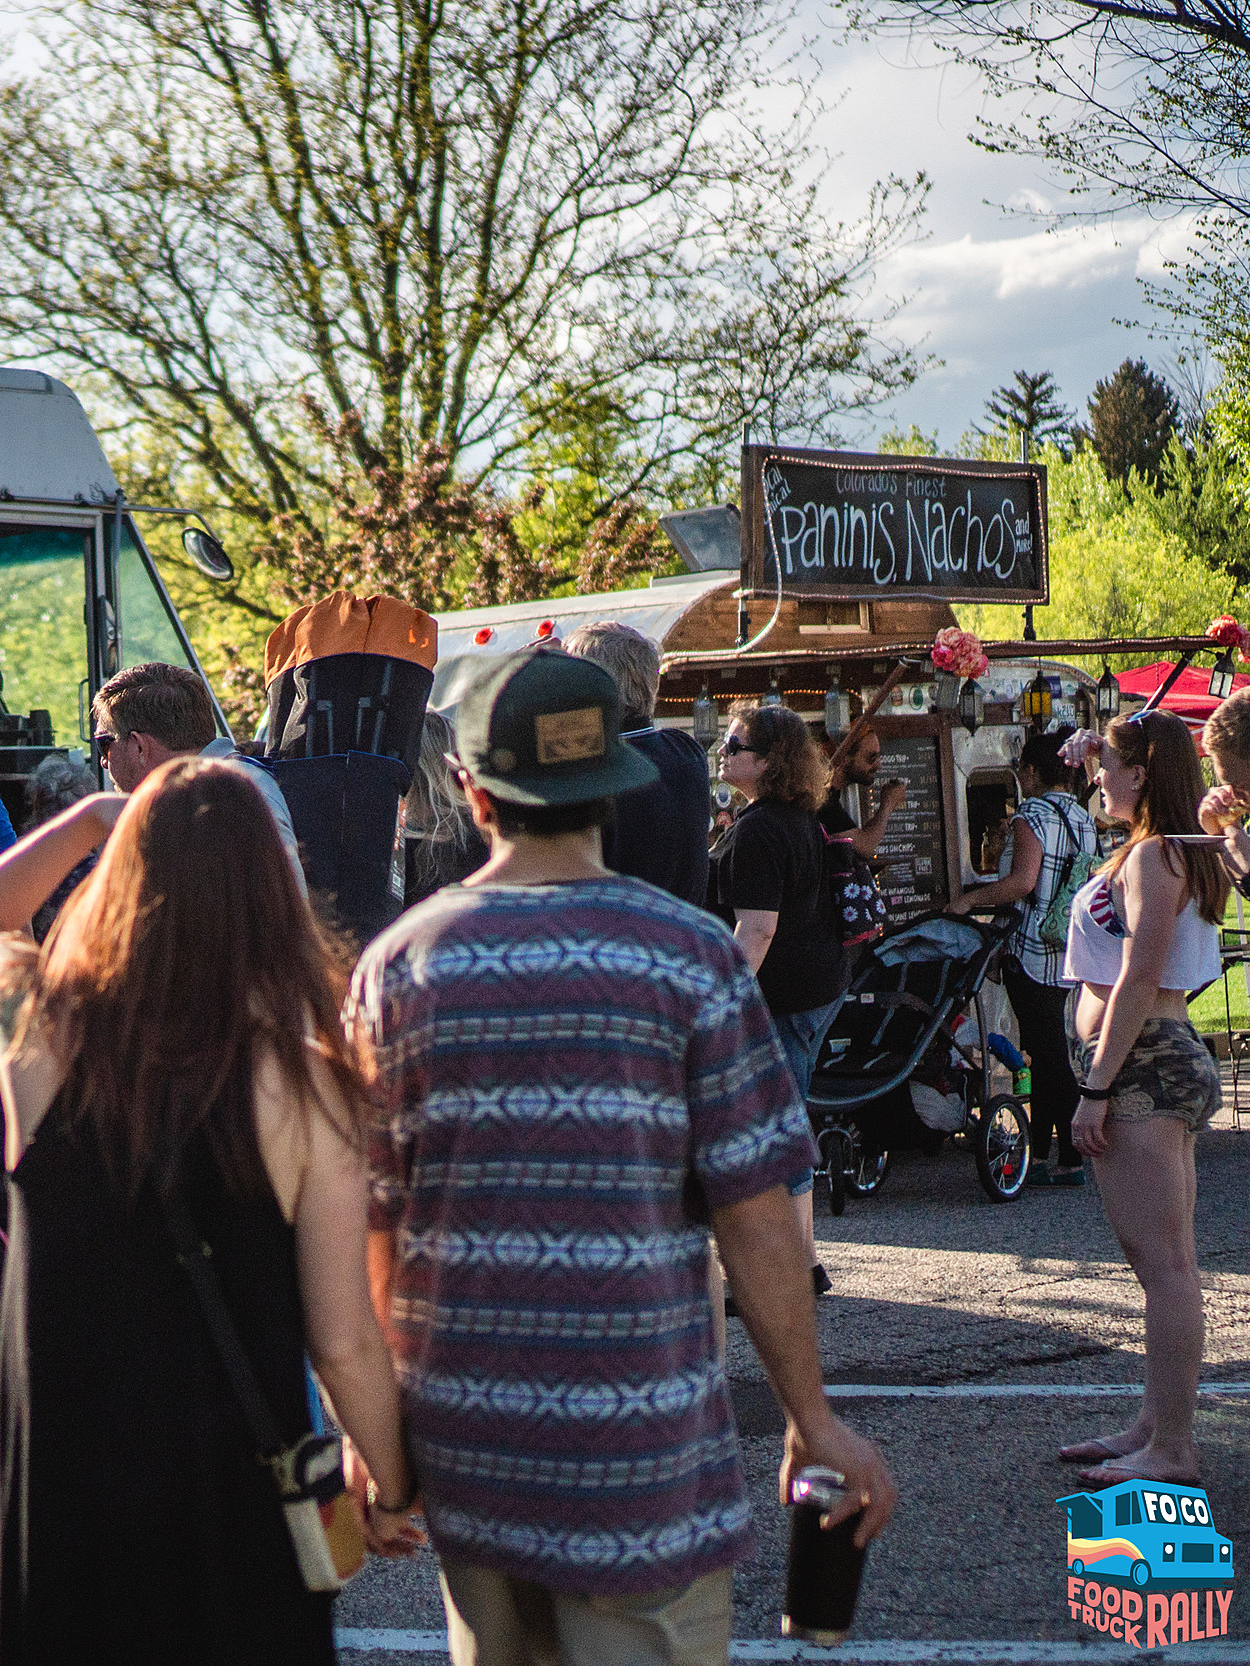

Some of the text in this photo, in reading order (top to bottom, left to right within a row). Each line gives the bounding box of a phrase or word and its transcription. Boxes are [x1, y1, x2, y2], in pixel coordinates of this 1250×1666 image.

[835, 470, 946, 498] Colorado's Finest
[906, 489, 1016, 581] Nachos
[1015, 511, 1030, 535] and
